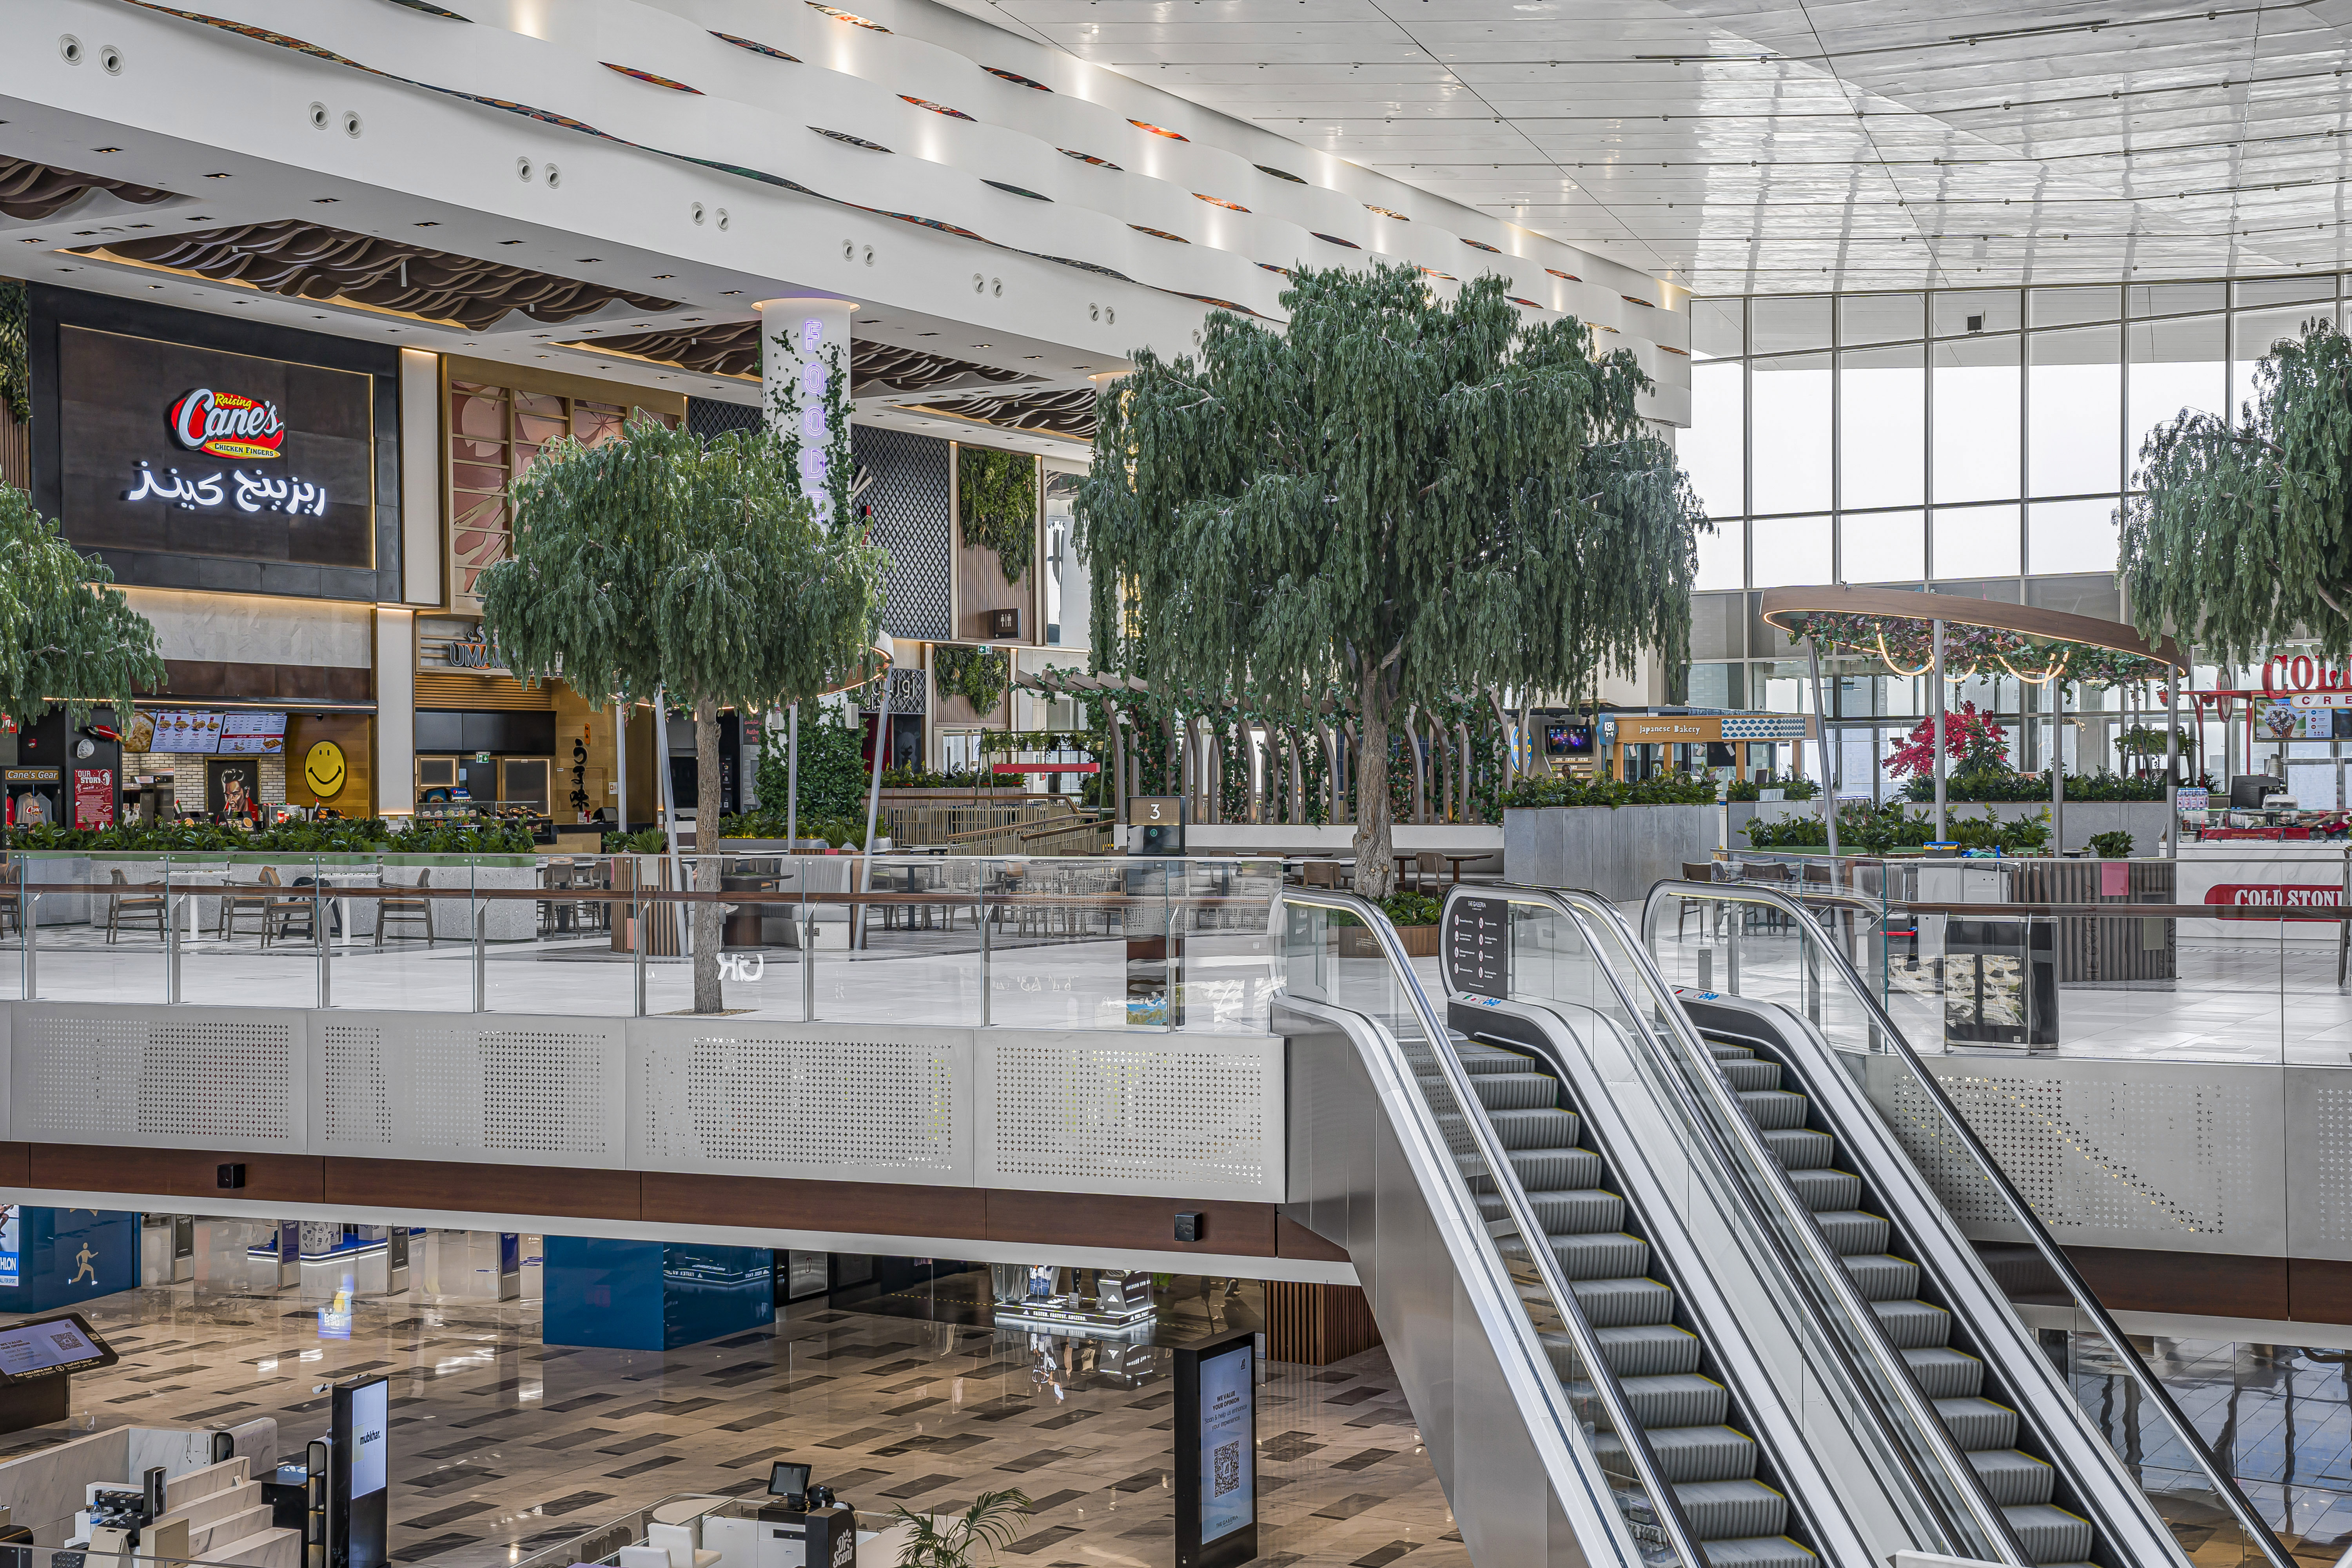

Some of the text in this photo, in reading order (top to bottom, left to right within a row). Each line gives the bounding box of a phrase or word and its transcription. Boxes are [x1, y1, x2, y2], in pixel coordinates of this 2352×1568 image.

[215, 394, 252, 410] Raising
[179, 388, 285, 446] Cane's
[128, 461, 325, 517] ريزينج كينز
[1604, 721, 1614, 731] KEKI
[1639, 725, 1700, 735] Japanese Bakery
[8, 771, 58, 779] Cane's Gear
[1150, 804, 1160, 819] 3
[2234, 889, 2283, 906] COLD
[1223, 1390, 1236, 1400] VALUE
[1212, 1396, 1240, 1411] YOUR OPINION
[1205, 1416, 1214, 1425] Scan
[1232, 1404, 1247, 1414] enhance
[1212, 1422, 1220, 1432] your
[360, 1430, 381, 1446] mubkhar.
[1222, 1515, 1239, 1526] GALLERIA
[837, 1535, 848, 1553] Dr
[833, 1546, 853, 1568] Scent
